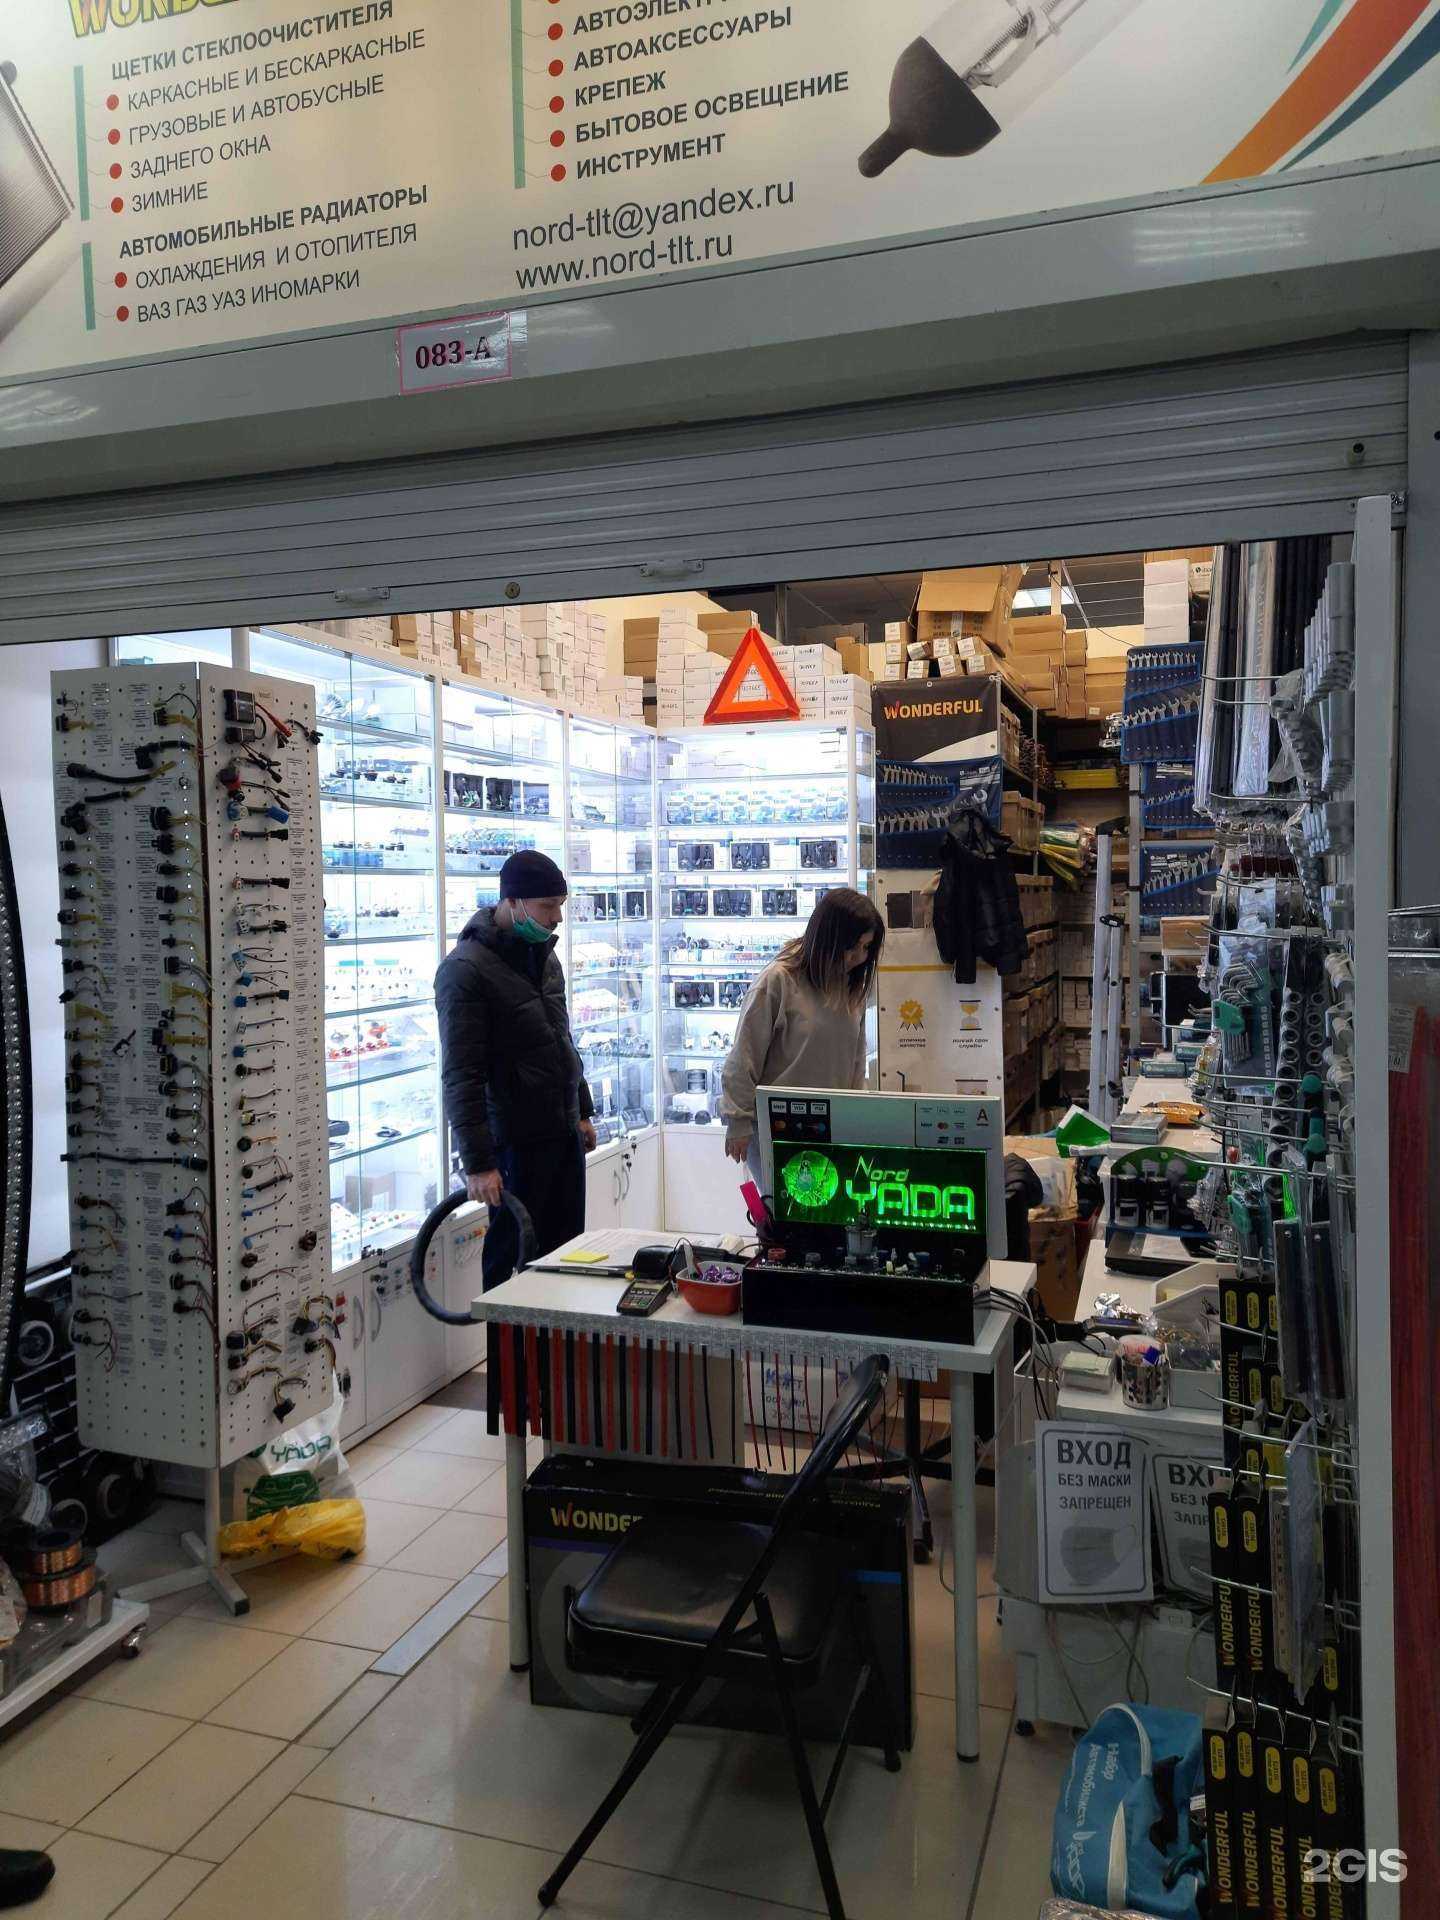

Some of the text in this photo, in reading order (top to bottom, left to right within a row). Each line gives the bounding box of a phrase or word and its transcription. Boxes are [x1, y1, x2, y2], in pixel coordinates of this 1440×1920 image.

[112, 1, 393, 80] ЩЕТКИ СТЕКЛООЧИСТИТЕЛЯ
[573, 6, 792, 71] АВТОАКСЕССУАРЫ
[128, 29, 425, 111] КАРКАСНЫЕ И БЕСКАРКАСНЫЕ
[575, 70, 666, 107] КРЕПЕЖ
[129, 74, 384, 145] ГРУЗОВЫЕ И АВТОБУСНЫЕ
[576, 71, 849, 143] БЫТОВОЕ ОСВЕЩЕНИЕ
[130, 134, 271, 180] ЗАДНЕГО ОКНА
[577, 133, 726, 180] ИНСТРУМЕНТ
[119, 184, 428, 259] АВТОМОБИЛЬНЫЕ РАДИАТОРЫ
[132, 181, 208, 213] ЗИМНИЕ
[513, 180, 795, 250] nord-tlt@yandex.ru
[135, 223, 417, 290] ОХЛАЖДЕНИЯ И ОТОПИТЕЛЯ
[516, 232, 733, 289] www.nord-tlt.ru
[138, 269, 360, 323] ВАЗ ГАЗ УАЗ ИНОМАРКИ
[884, 699, 983, 720] WONDERFUL
[855, 1154, 909, 1182] Nord
[846, 1180, 975, 1220] YADA
[1057, 1439, 1132, 1469] ВХОД
[1058, 1473, 1132, 1488] БЕЗ МАСКИ
[1059, 1496, 1132, 1513] ЗАПРЕЩЕН
[1170, 1492, 1196, 1506] БЕЗ
[550, 1501, 643, 1532] WONDE
[1214, 1809, 1233, 1905] WONDERFUL
[1241, 1809, 1261, 1909] WONDERFUL
